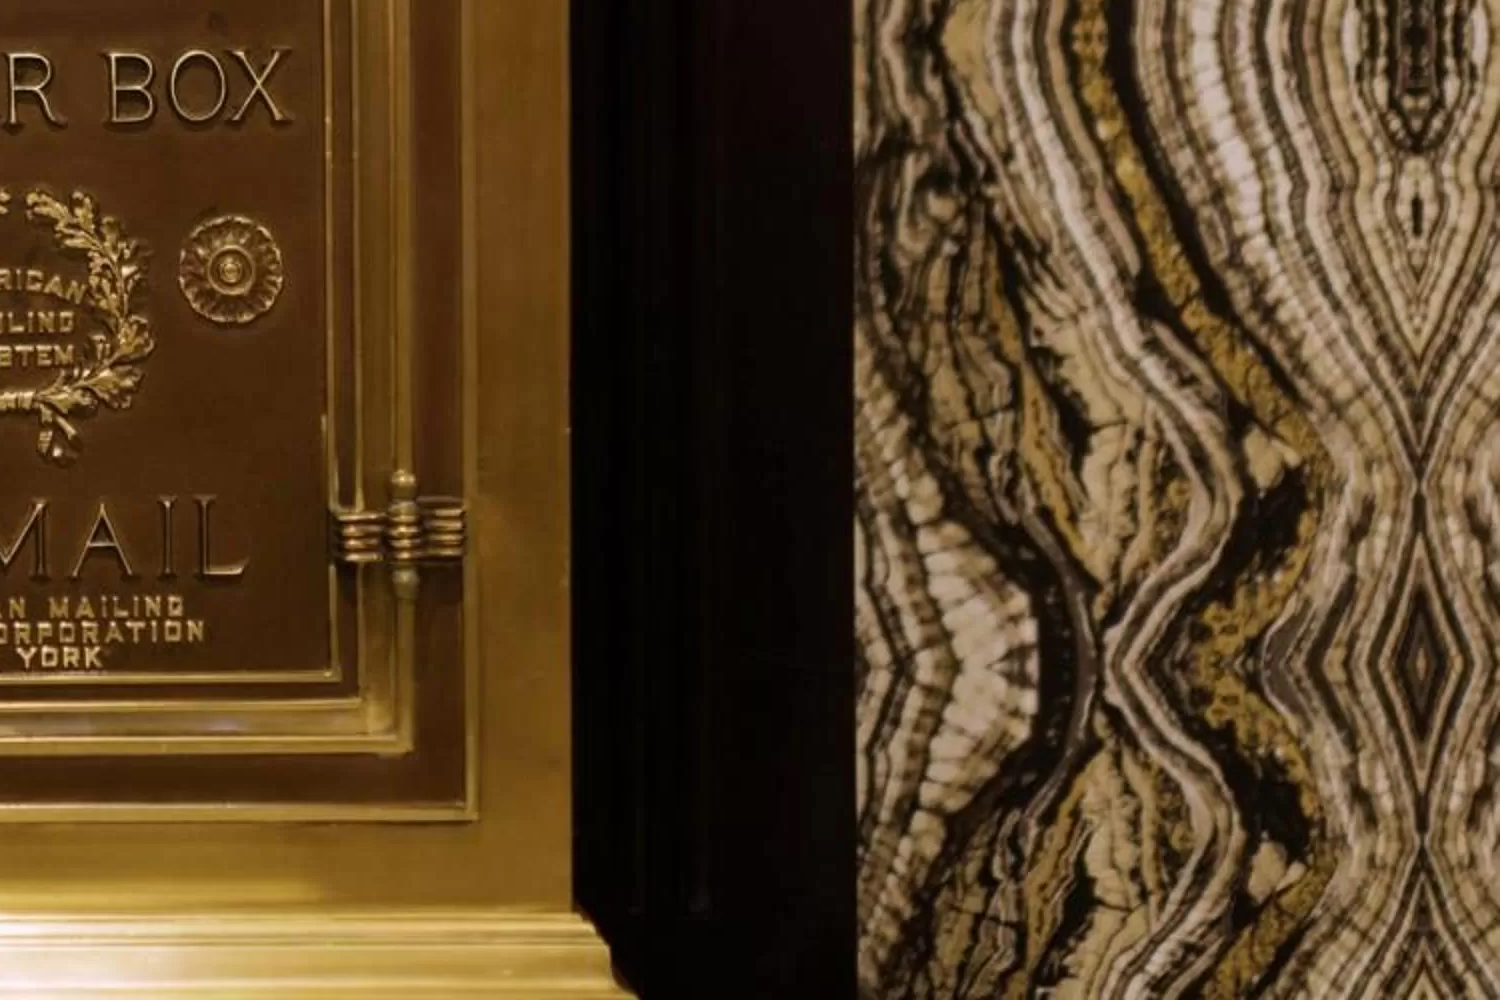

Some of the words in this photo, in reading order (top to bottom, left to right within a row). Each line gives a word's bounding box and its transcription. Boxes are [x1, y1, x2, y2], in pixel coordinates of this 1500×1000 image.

[103, 47, 294, 130] BOX
[49, 596, 186, 619] MAILING
[16, 645, 105, 669] YORK
